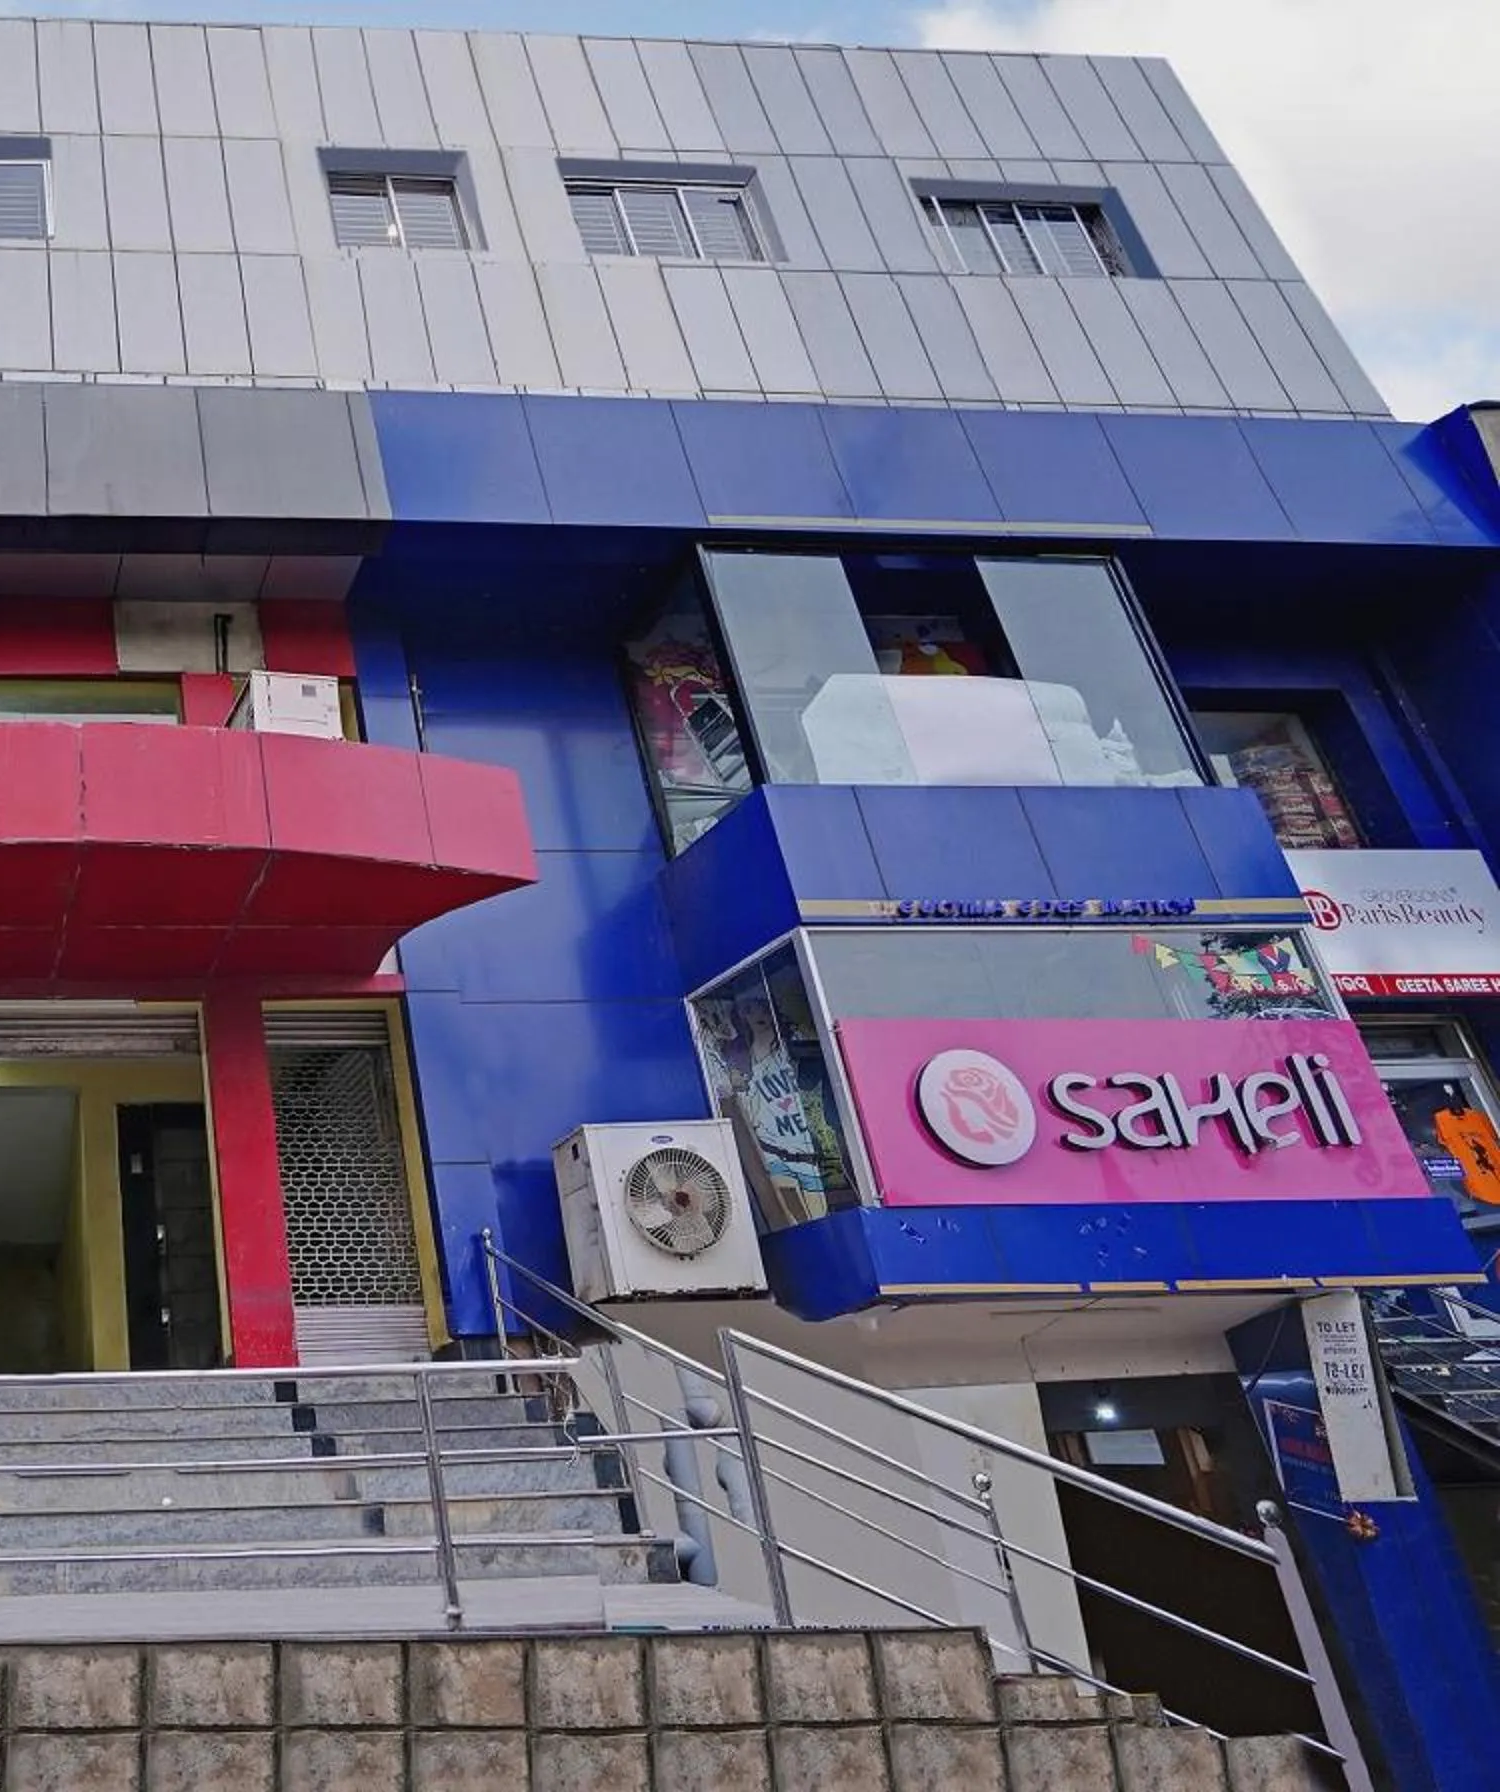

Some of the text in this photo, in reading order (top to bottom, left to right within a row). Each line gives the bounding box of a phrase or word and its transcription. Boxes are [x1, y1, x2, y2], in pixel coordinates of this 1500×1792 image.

[1395, 978, 1444, 993] GEETA
[1444, 978, 1491, 993] SAREE
[774, 1113, 808, 1136] ME
[1316, 1321, 1356, 1333] TO LET
